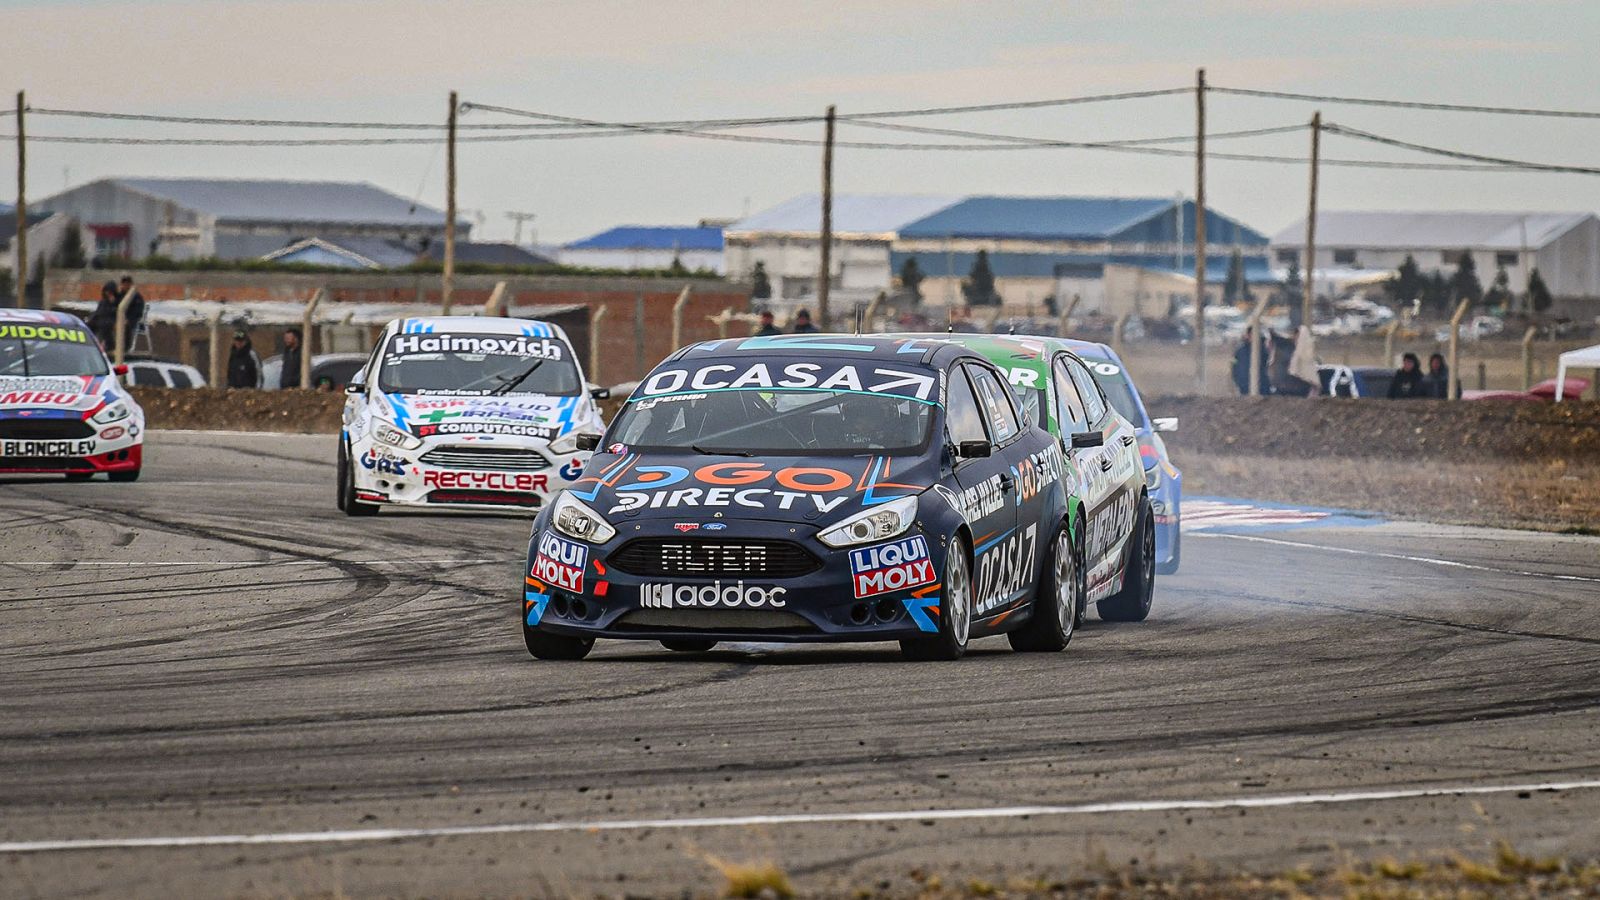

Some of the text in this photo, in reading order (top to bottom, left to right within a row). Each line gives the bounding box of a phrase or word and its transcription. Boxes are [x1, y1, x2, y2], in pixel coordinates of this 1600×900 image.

[395, 335, 561, 357] Haimovich
[644, 363, 864, 395] OCASA
[438, 423, 551, 437] COMPUTACION
[5, 440, 96, 456] BLANCALEY
[608, 487, 849, 515] DIRECTV
[540, 533, 584, 568] LIQUI
[855, 537, 926, 572] LIQUI
[535, 555, 582, 589] MOLY
[859, 560, 929, 595] MOLY
[976, 532, 1023, 615] OCASA
[675, 580, 787, 607] addoc
